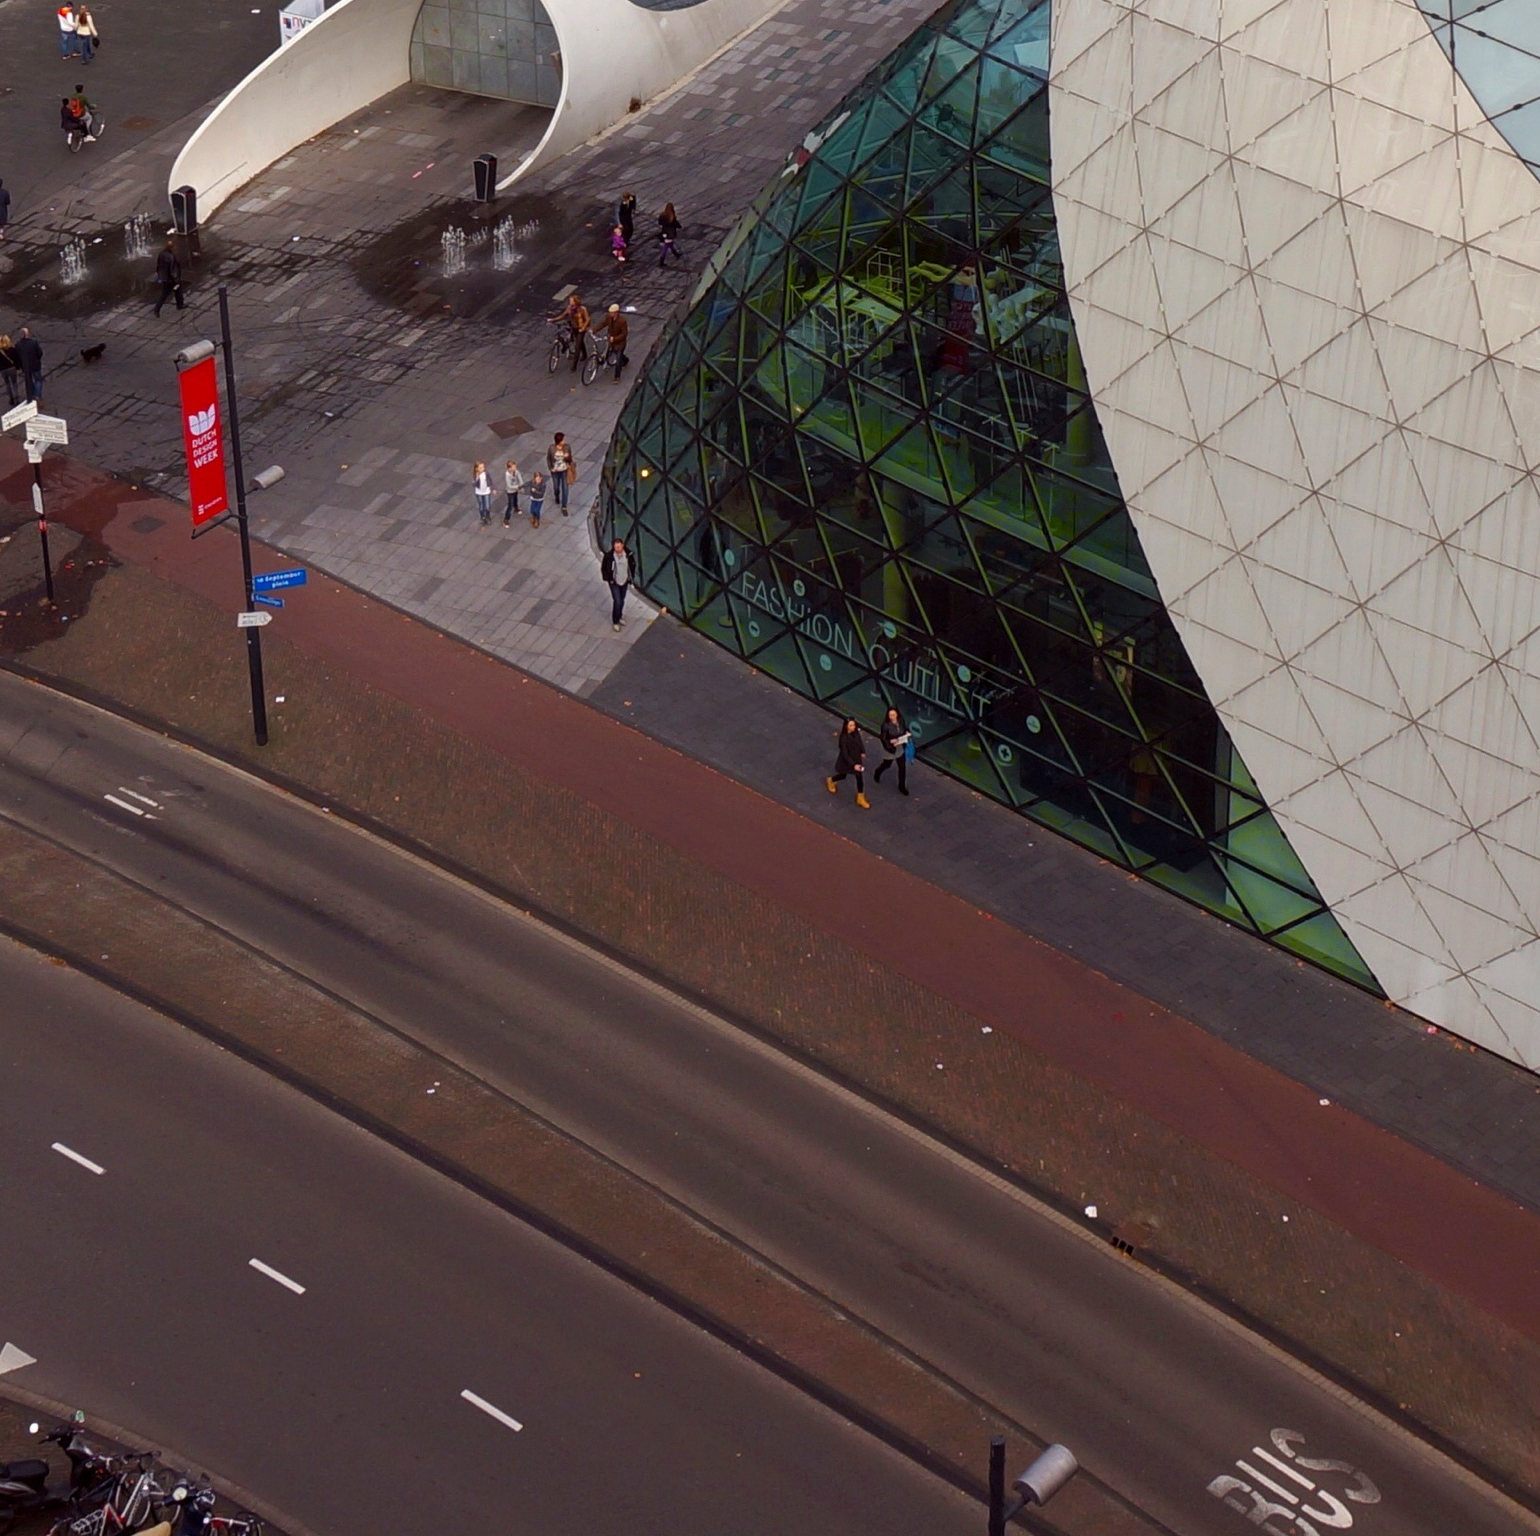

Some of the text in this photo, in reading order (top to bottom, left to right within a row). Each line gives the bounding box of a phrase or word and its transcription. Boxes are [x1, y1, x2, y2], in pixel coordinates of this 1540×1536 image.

[192, 429, 217, 448] DUTCH
[192, 439, 218, 457] DESIGN
[193, 448, 219, 469] WEEK
[741, 570, 853, 657] FASHION
[1206, 1427, 1381, 1536] BUS
